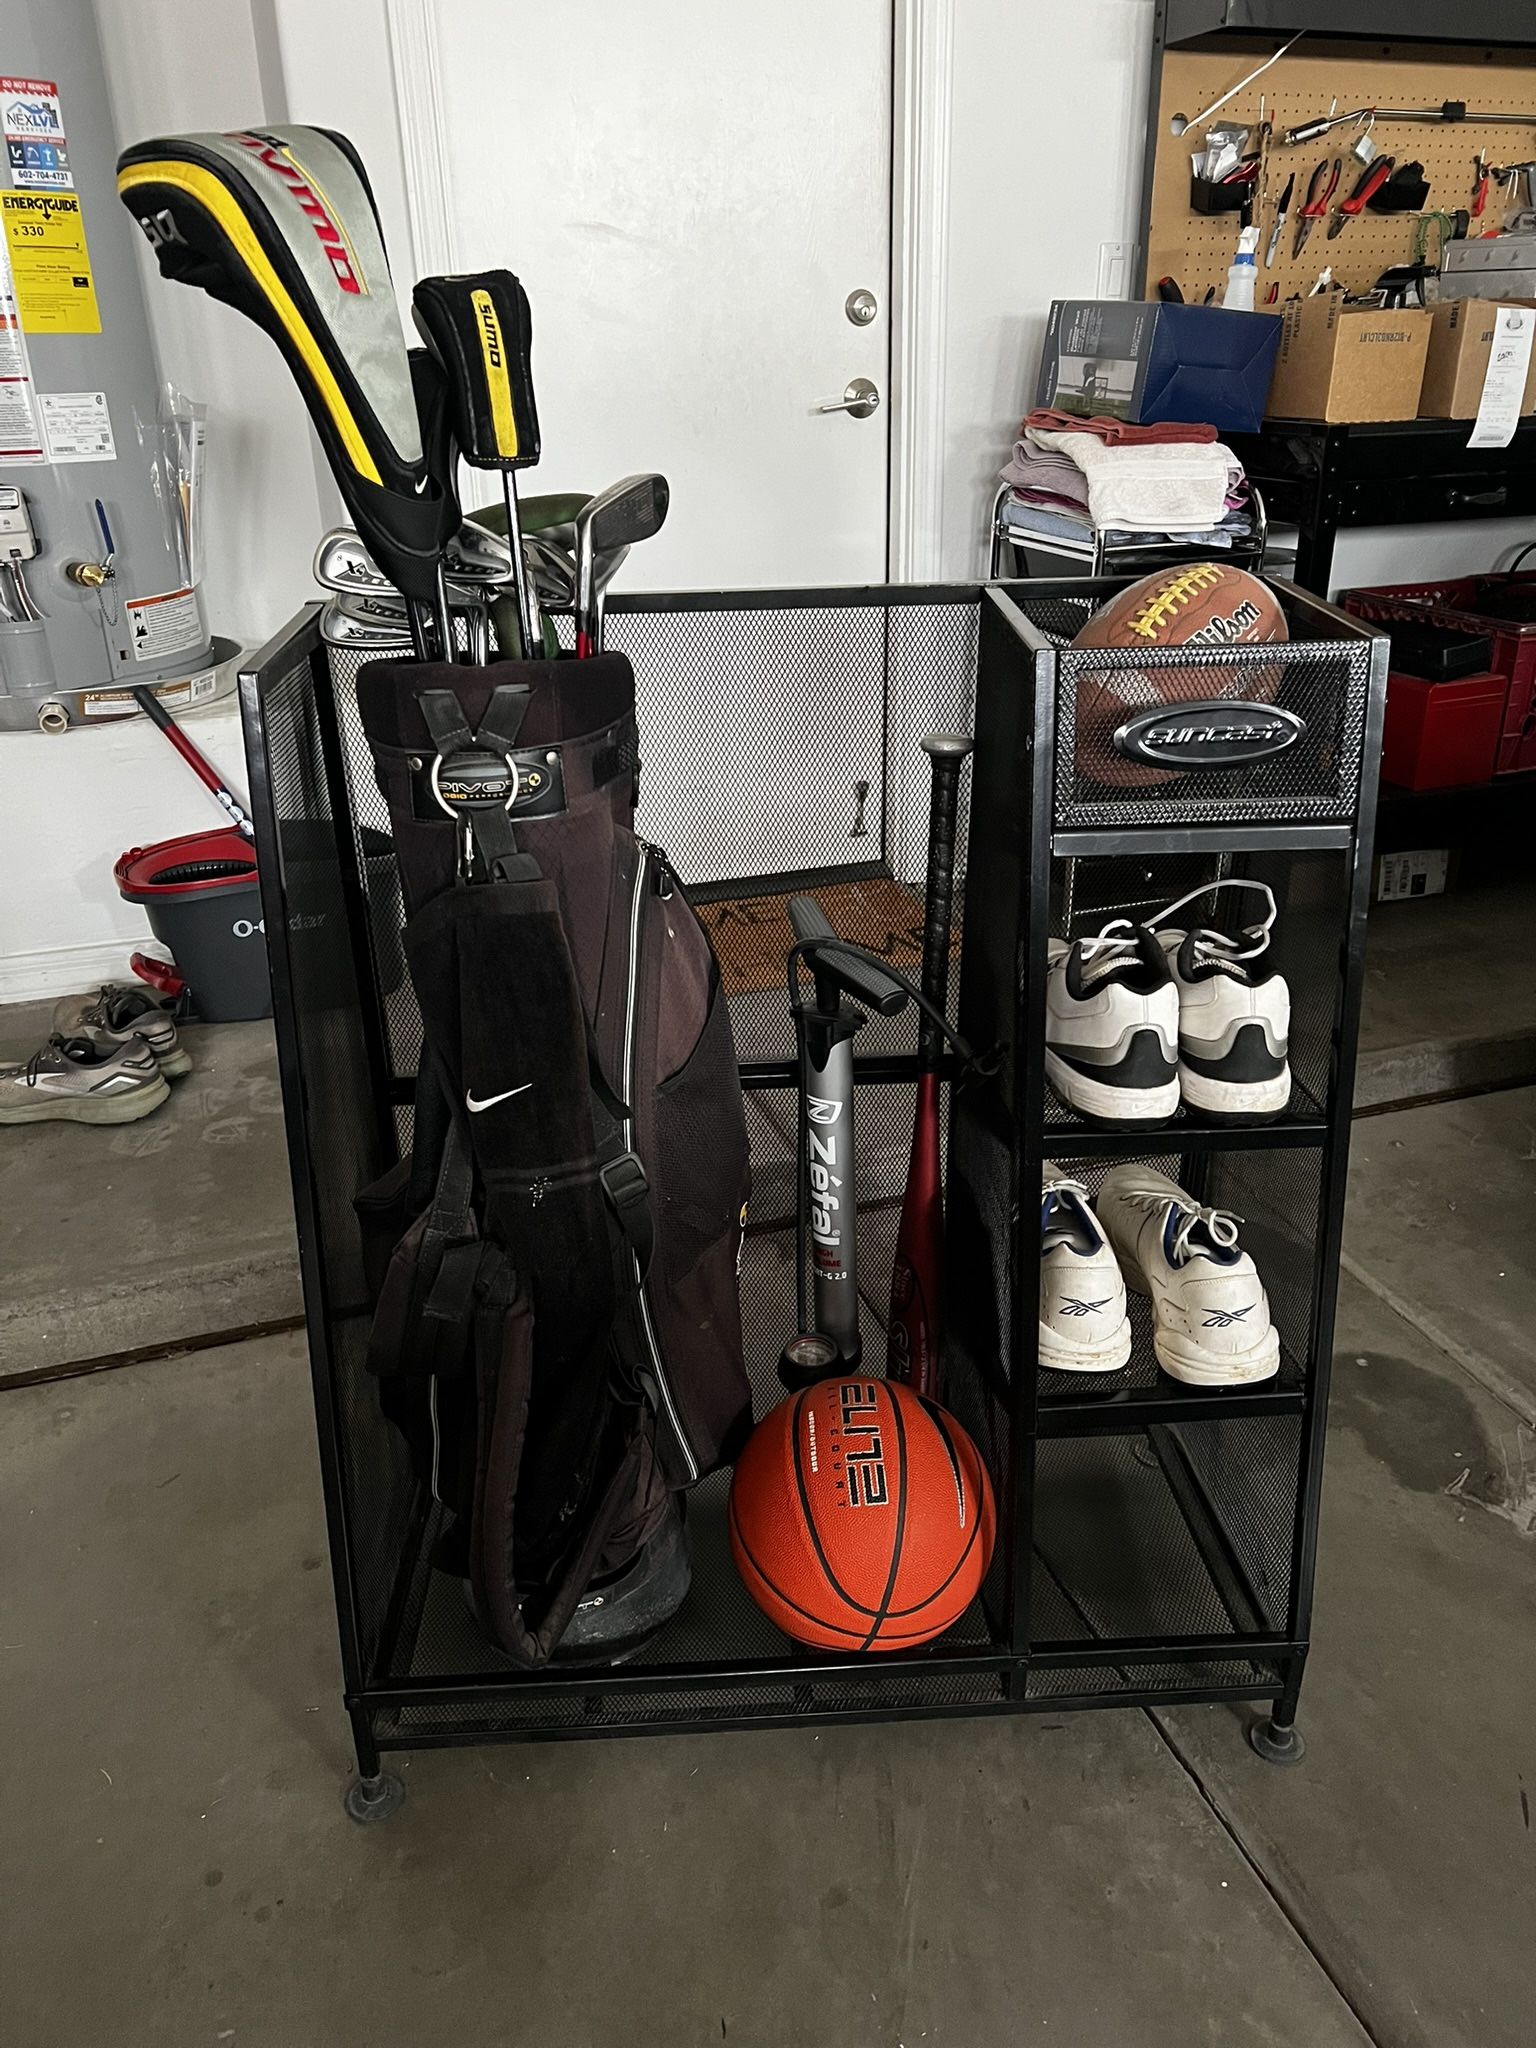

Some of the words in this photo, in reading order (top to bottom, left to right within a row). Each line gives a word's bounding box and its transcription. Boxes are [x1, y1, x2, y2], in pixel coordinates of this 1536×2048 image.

[18, 171, 68, 181] 602-704-4731
[13, 227, 19, 236] $
[22, 225, 45, 237] 330
[478, 303, 502, 368] SUMO
[808, 1127, 842, 1247] Zéfal
[834, 1270, 848, 1281] 2.0
[839, 1383, 889, 1508] ELITE
